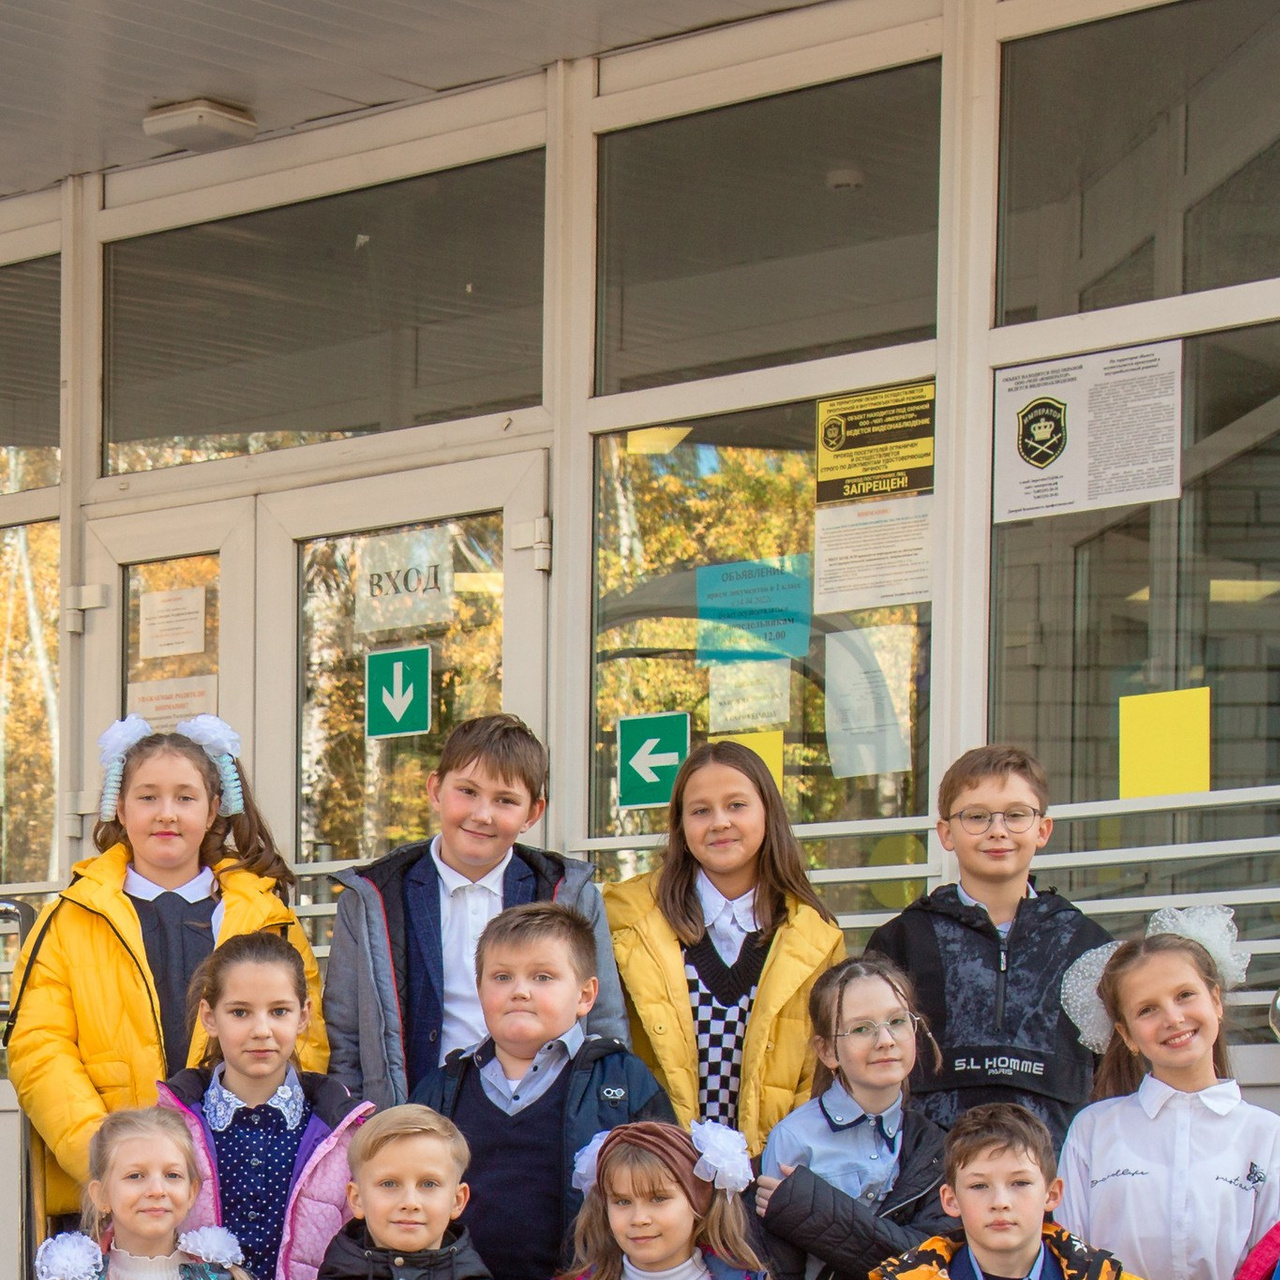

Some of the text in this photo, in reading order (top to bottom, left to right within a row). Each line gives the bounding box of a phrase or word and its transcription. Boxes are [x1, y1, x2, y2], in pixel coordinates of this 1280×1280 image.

[1023, 408, 1062, 425] ИМПЕРАТОР
[833, 451, 854, 459] ПРОХОД
[854, 446, 888, 456] ПОСЕТИТЕЛЕЙ
[855, 451, 900, 462] ОСУЩЕСТВЛЯЕТСЯ
[820, 465, 838, 473] СТРОГО
[847, 459, 881, 469] ДОКУМЕНТАМ
[843, 476, 908, 496] ЗАПРЕЩЕН!
[369, 564, 441, 597] ВХОД
[721, 564, 786, 583] ОБЪЯВЛЕНИЕ
[764, 629, 786, 642] 12.00
[954, 1056, 1045, 1075] S.L HOMME
[988, 1068, 1013, 1076] PARIS
